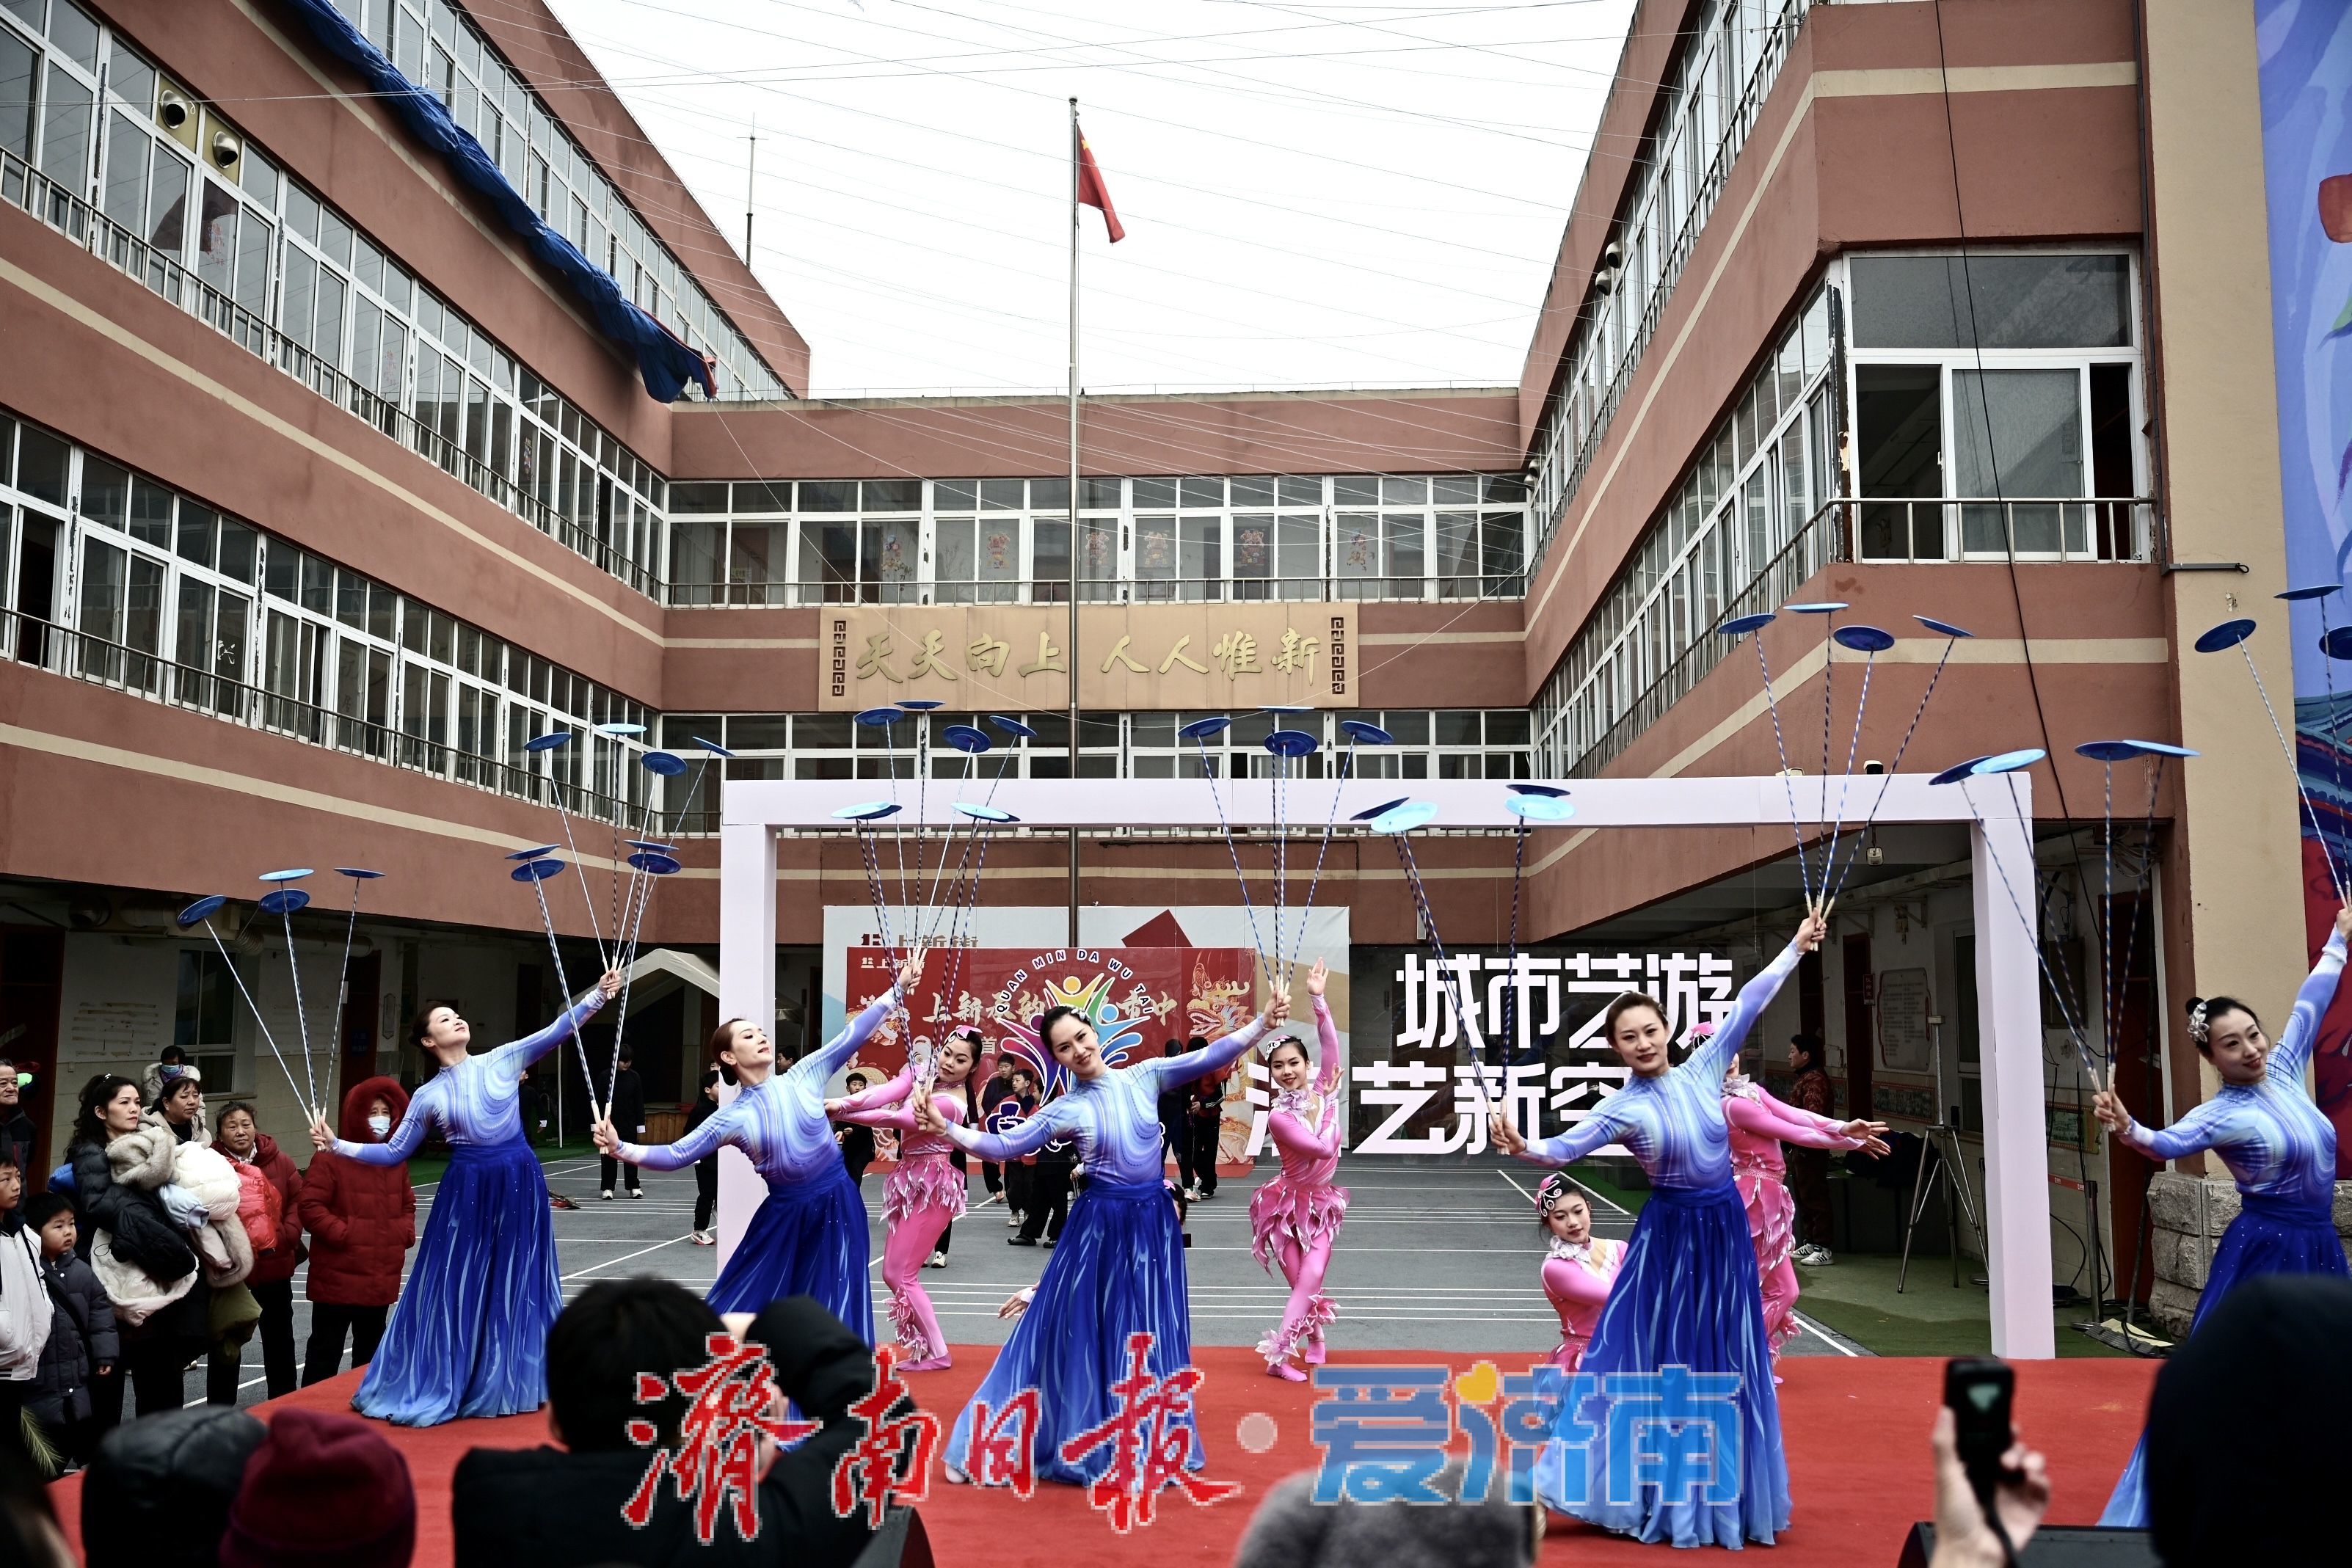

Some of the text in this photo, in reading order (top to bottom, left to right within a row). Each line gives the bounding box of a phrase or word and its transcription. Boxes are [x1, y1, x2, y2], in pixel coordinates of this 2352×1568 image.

[856, 629, 1066, 683] 天天向上
[997, 949, 1153, 1013] QUAN MIN DA WU TAI
[1396, 953, 1732, 1049] 城市艺游
